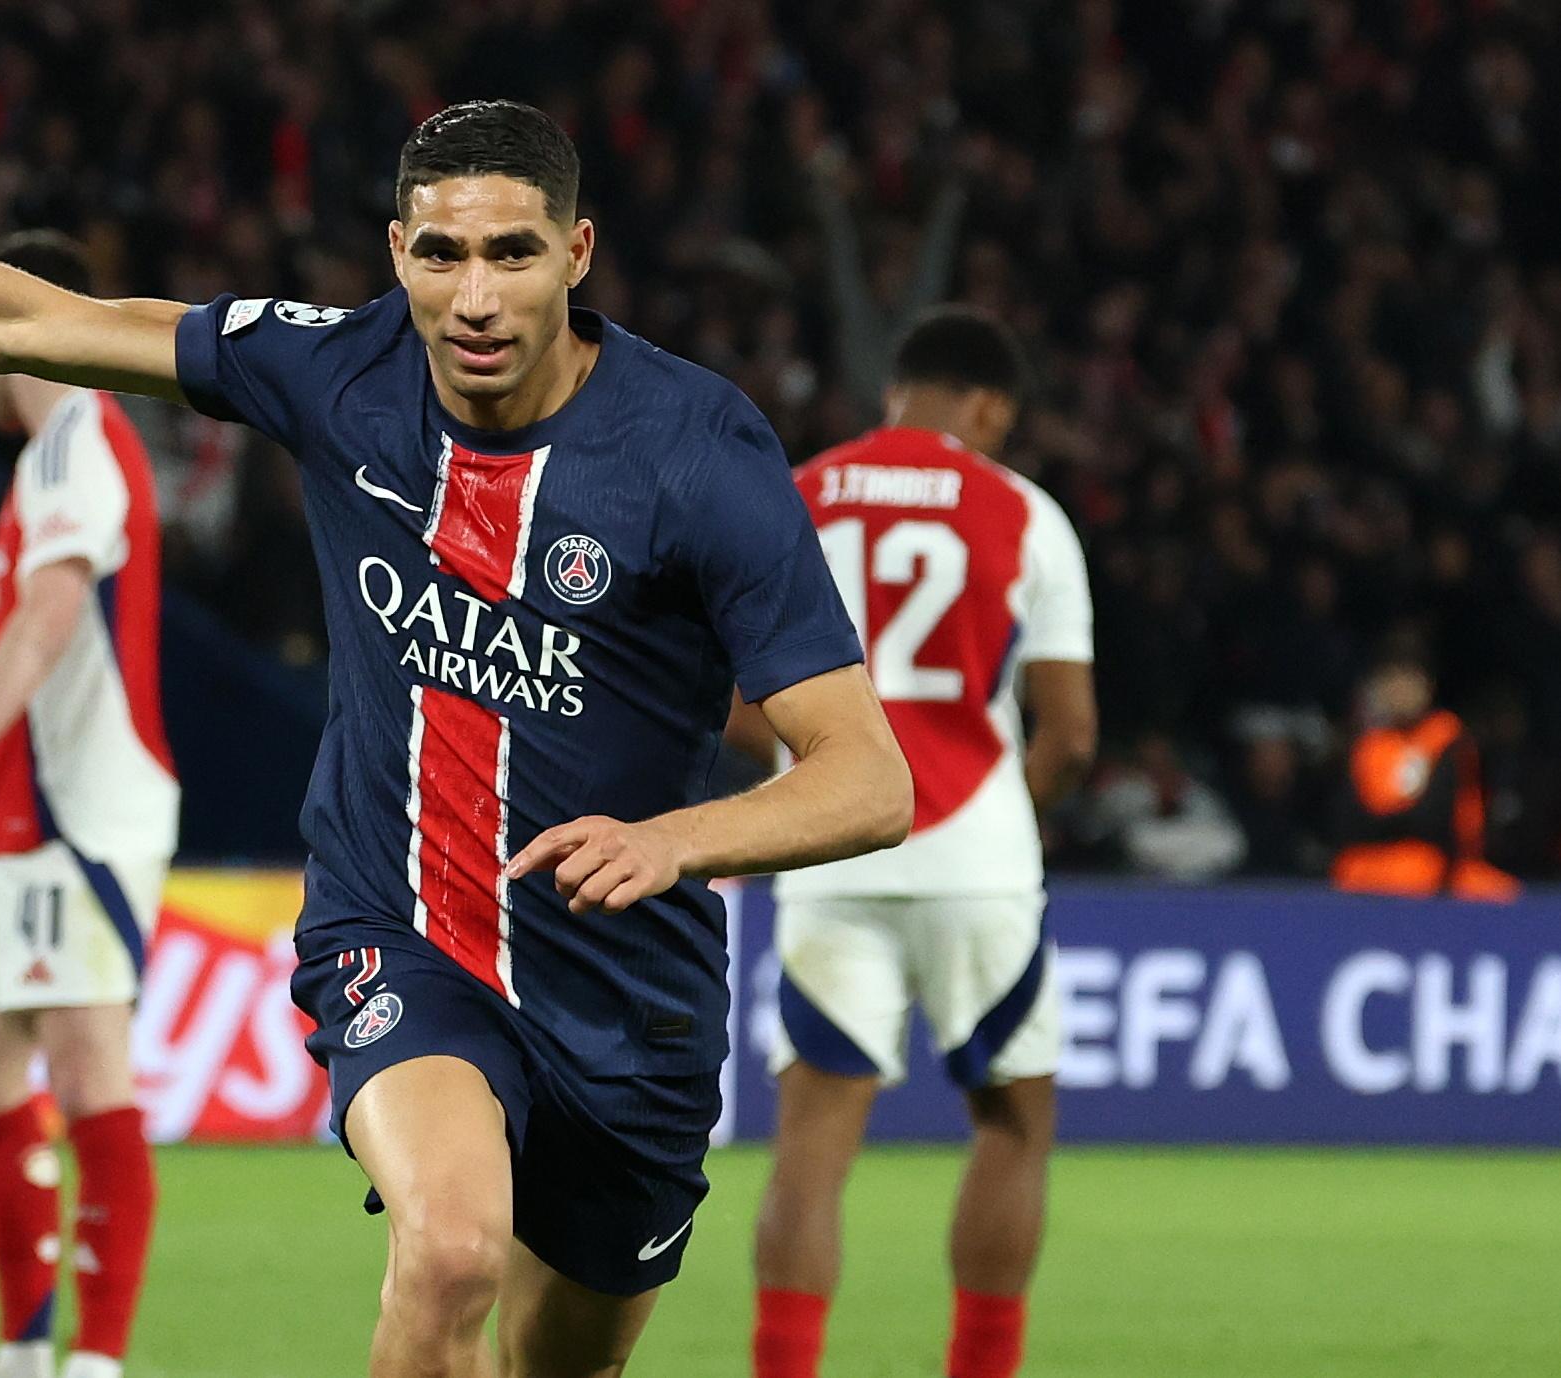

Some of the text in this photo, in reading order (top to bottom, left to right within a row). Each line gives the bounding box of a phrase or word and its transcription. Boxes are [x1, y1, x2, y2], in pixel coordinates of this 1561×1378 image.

[558, 538, 603, 560] PARIS
[817, 516, 970, 703] 12
[358, 556, 585, 679] QATAR
[399, 638, 584, 717] AIRWAYS
[1055, 946, 1561, 1095] EFA CHA
